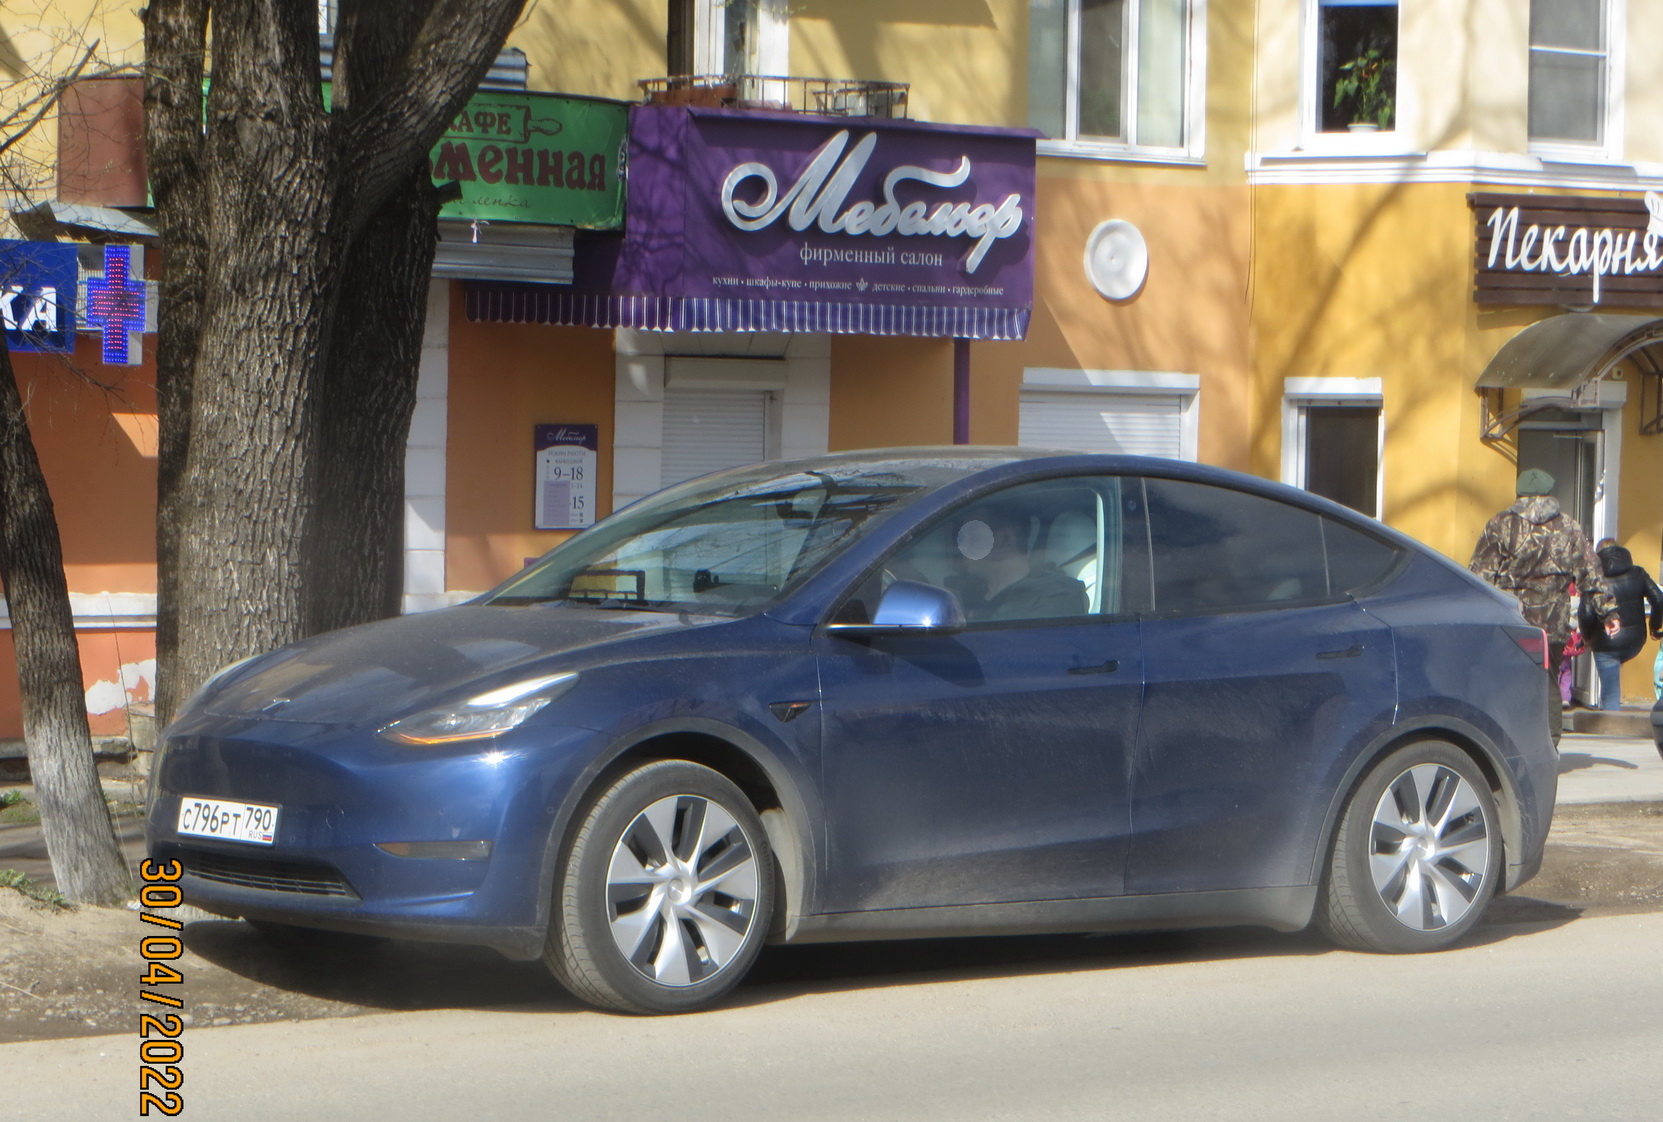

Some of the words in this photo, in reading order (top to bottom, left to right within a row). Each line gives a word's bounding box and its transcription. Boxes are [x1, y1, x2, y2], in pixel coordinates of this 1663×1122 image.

[450, 109, 512, 135] АФЕ
[429, 141, 606, 192] менная
[800, 242, 896, 266] фирменный
[900, 251, 943, 266] салон
[1487, 207, 1663, 303] Пекарня
[712, 277, 739, 287] кухни
[746, 276, 802, 290] шкафы-купе
[809, 281, 852, 291] прихожие
[872, 283, 906, 293] детские
[912, 284, 945, 293] спальни
[952, 285, 1004, 297] гардеробные
[183, 803, 241, 835] С796РТ
[245, 807, 272, 831] 790
[248, 830, 262, 840] RUS
